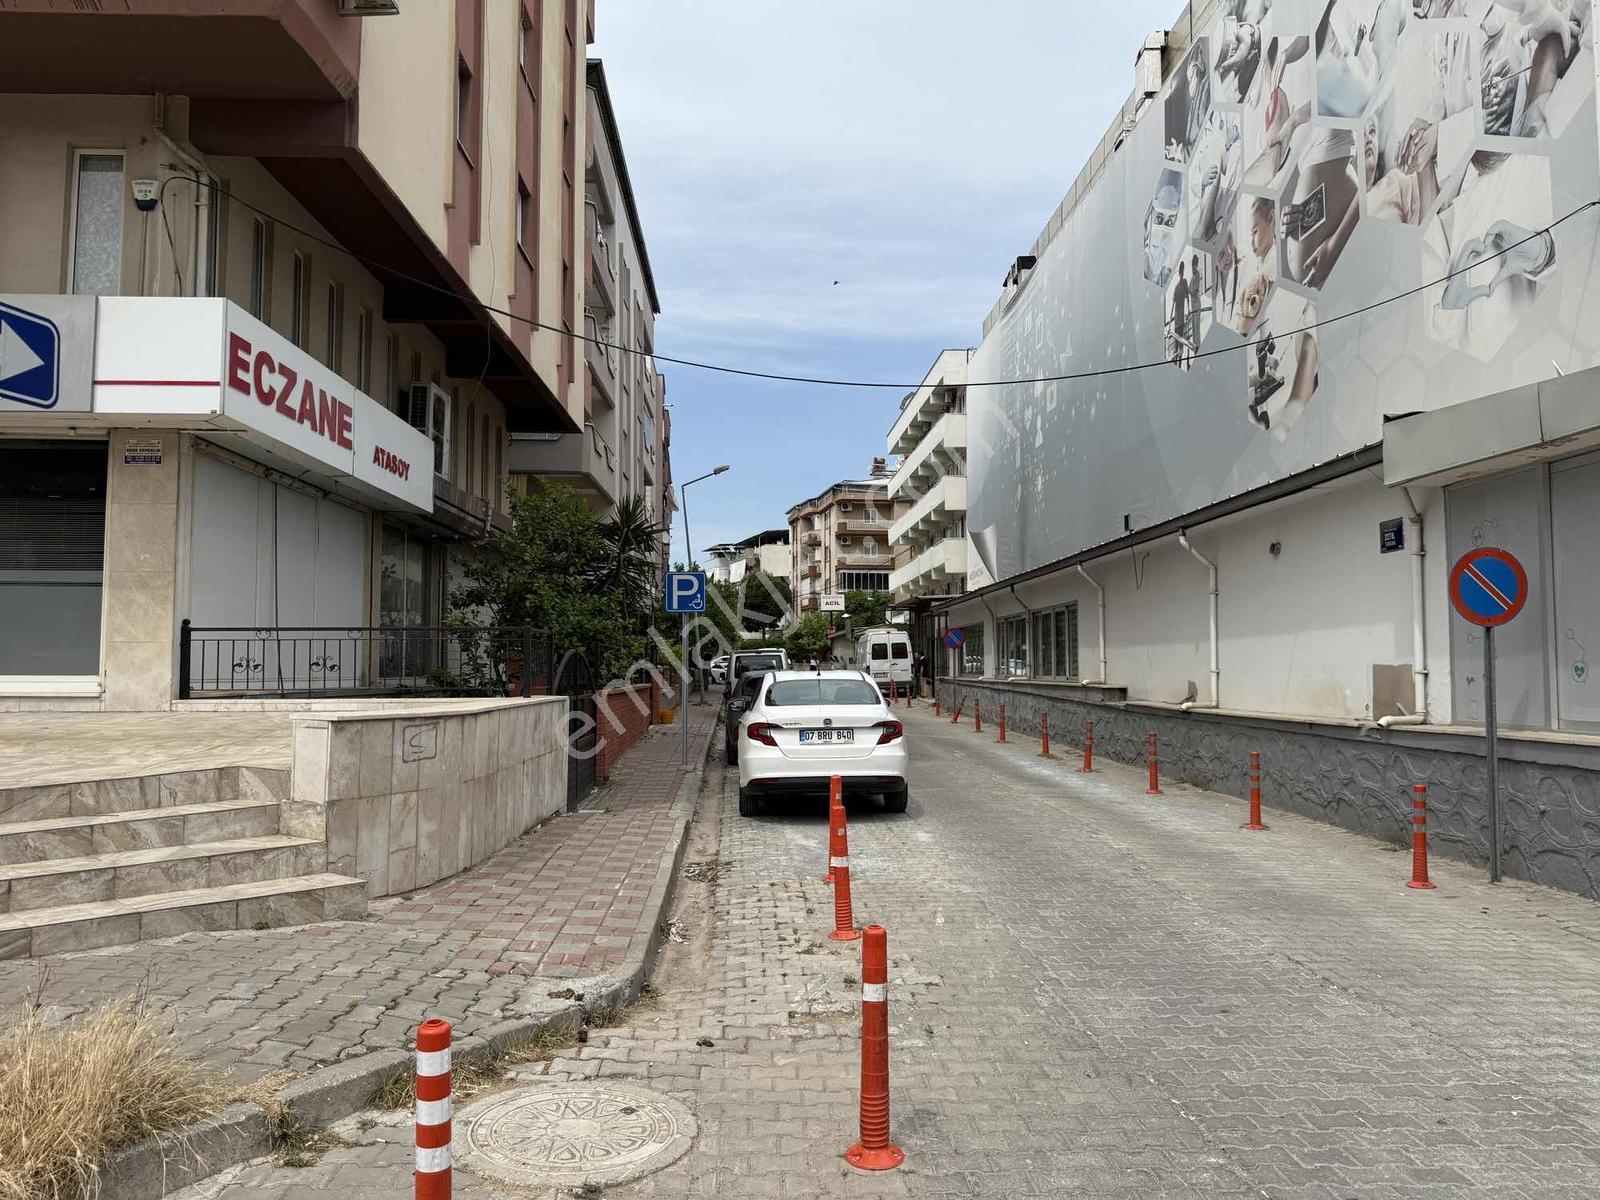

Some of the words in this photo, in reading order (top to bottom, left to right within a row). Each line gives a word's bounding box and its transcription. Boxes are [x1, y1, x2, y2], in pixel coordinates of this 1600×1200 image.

[228, 331, 353, 451] ECZANE
[372, 445, 410, 481] ATASOY
[672, 574, 699, 609] P
[805, 731, 815, 740] 07
[817, 731, 833, 740] BRU
[836, 730, 852, 740] 840
